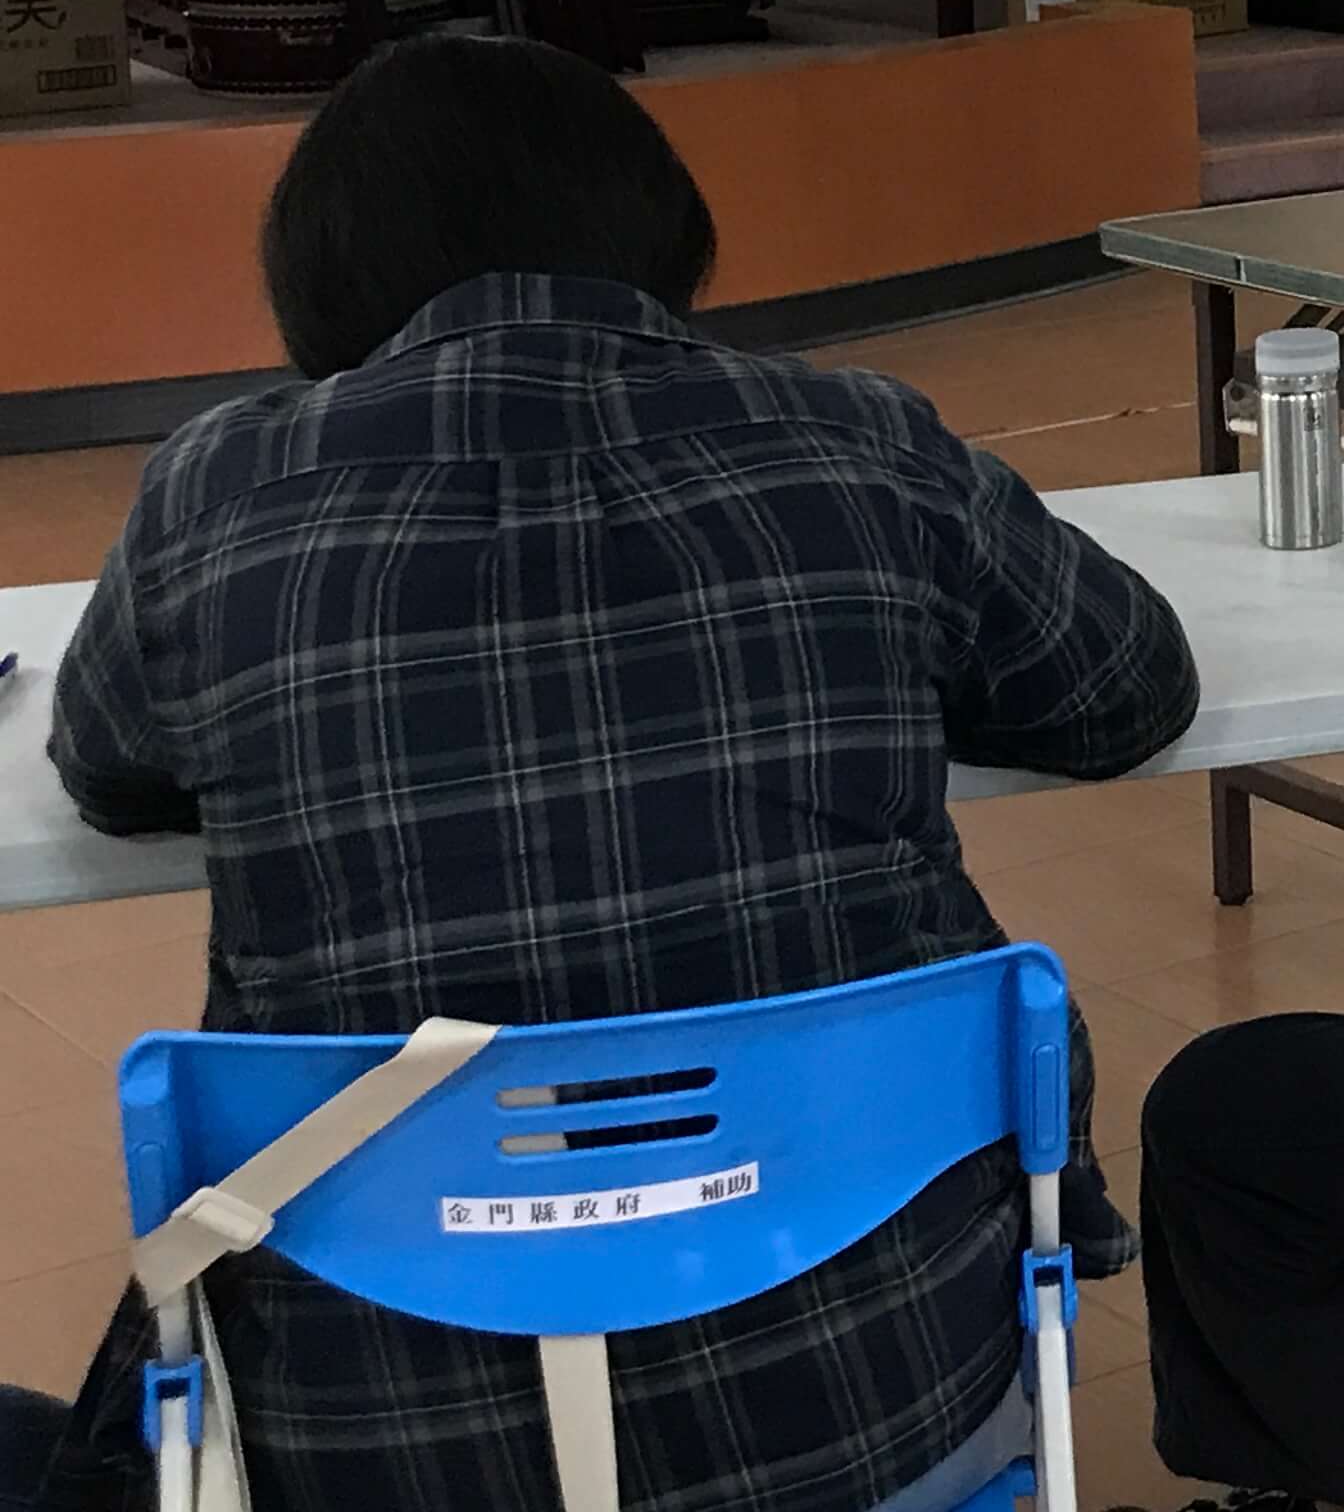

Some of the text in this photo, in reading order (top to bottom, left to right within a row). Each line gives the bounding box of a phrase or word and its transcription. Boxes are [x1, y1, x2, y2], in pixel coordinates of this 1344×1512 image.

[448, 1172, 752, 1224] 金門縣政府 補助
